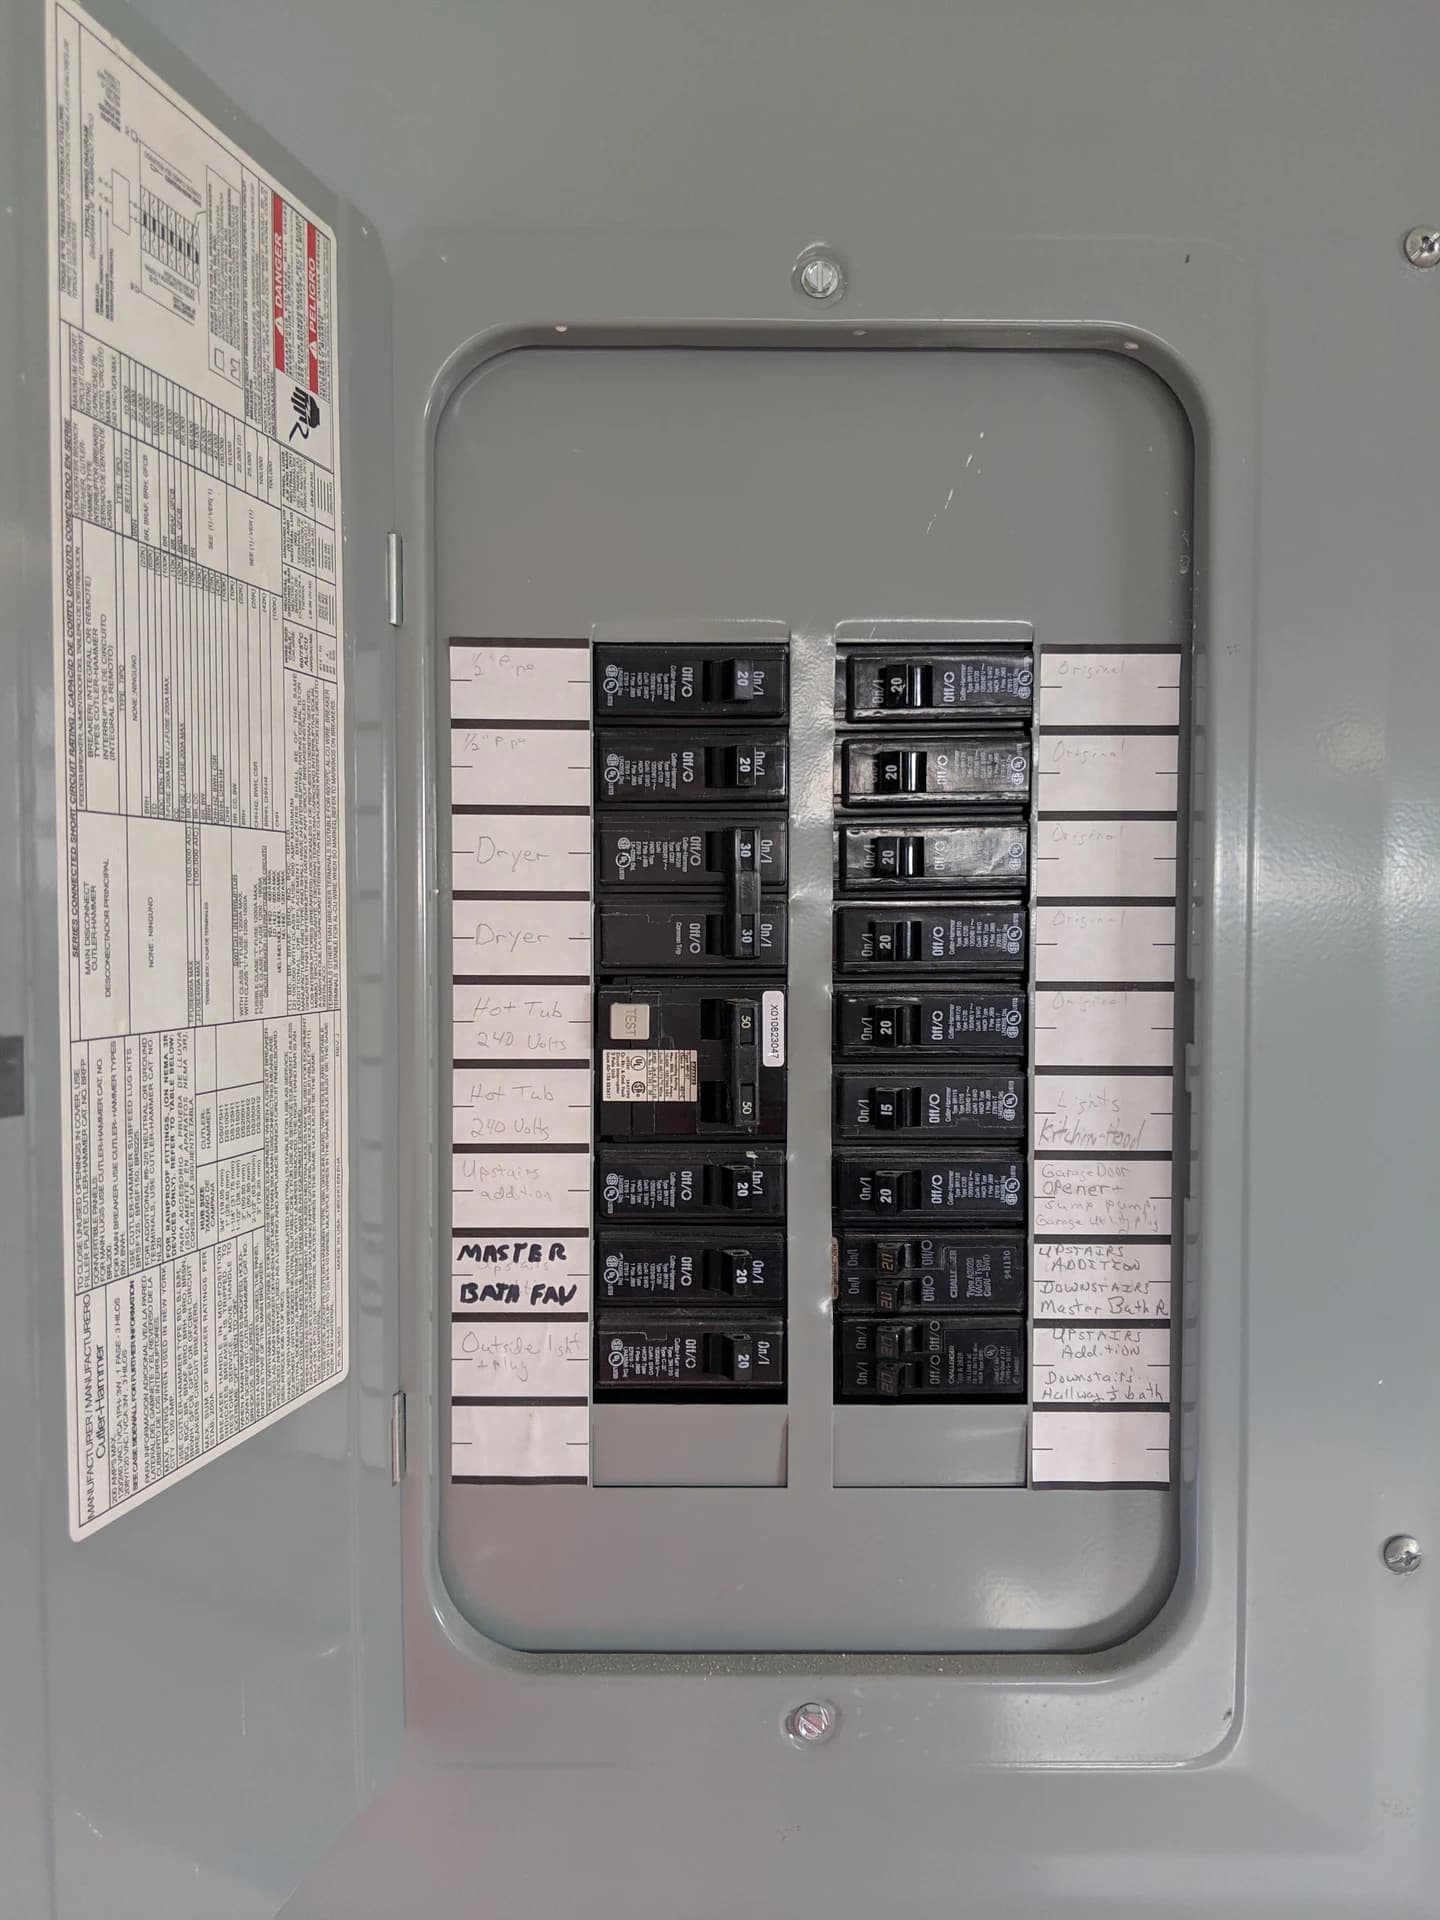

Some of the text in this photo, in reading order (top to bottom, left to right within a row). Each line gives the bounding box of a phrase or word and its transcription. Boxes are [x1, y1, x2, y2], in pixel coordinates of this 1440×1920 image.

[64, 456, 71, 471] EN
[65, 544, 73, 598] CIRCUITO
[66, 600, 74, 637] CORTO
[67, 640, 74, 656] DE
[67, 659, 75, 708] CAPACID
[737, 670, 749, 686] 20
[891, 677, 903, 693] 20
[739, 757, 751, 772] 20
[885, 764, 898, 780] 20
[68, 758, 76, 804] CIRCUIT
[69, 808, 77, 843] SHORT
[477, 836, 550, 872] Dryer
[740, 842, 751, 858] 30
[882, 850, 894, 865] 20
[70, 847, 78, 916] CONNECTED
[83, 881, 91, 947] DISCONNECT
[90, 885, 98, 971] CUTLER-HAMMER
[102, 859, 112, 998] DESCONECTADOR PRINCIPAL
[475, 923, 550, 952] Dryer
[741, 928, 753, 943] 30
[71, 919, 79, 958] SERIES
[879, 934, 892, 950] 20
[473, 997, 562, 1018] Hot Tub
[625, 1007, 637, 1036] TEST
[741, 1015, 751, 1029] 50
[880, 1021, 892, 1036] 20
[477, 1031, 567, 1051] 240 Volts
[470, 1083, 554, 1102] Hot Tub
[742, 1101, 752, 1115] 50
[880, 1104, 893, 1116] 15
[470, 1116, 550, 1140] 240 Volts
[462, 1160, 541, 1182] Upstairs
[737, 1182, 748, 1197] 20
[880, 1188, 892, 1204] 20
[456, 1242, 567, 1263] MASTER
[1038, 1244, 1124, 1258] UPSTAIRS
[881, 1253, 893, 1270] 20
[1051, 1257, 1140, 1272] ADDITION
[736, 1268, 748, 1284] 20
[949, 1249, 958, 1298] CHALLEGER
[459, 1282, 520, 1303] BATH
[1040, 1281, 1149, 1295] DOWNSTAIRS
[1040, 1296, 1169, 1315] Master Bath R
[462, 1331, 539, 1354] Outside
[1052, 1328, 1142, 1344] UPSTAIRS
[738, 1354, 750, 1369] 20
[1045, 1368, 1135, 1384] Downstairs
[1042, 1387, 1104, 1402] Hallway
[1125, 1381, 1162, 1401] bath
[94, 1344, 106, 1459] Cutler-Hammer
[84, 1413, 95, 1519] MANUFACTURER
